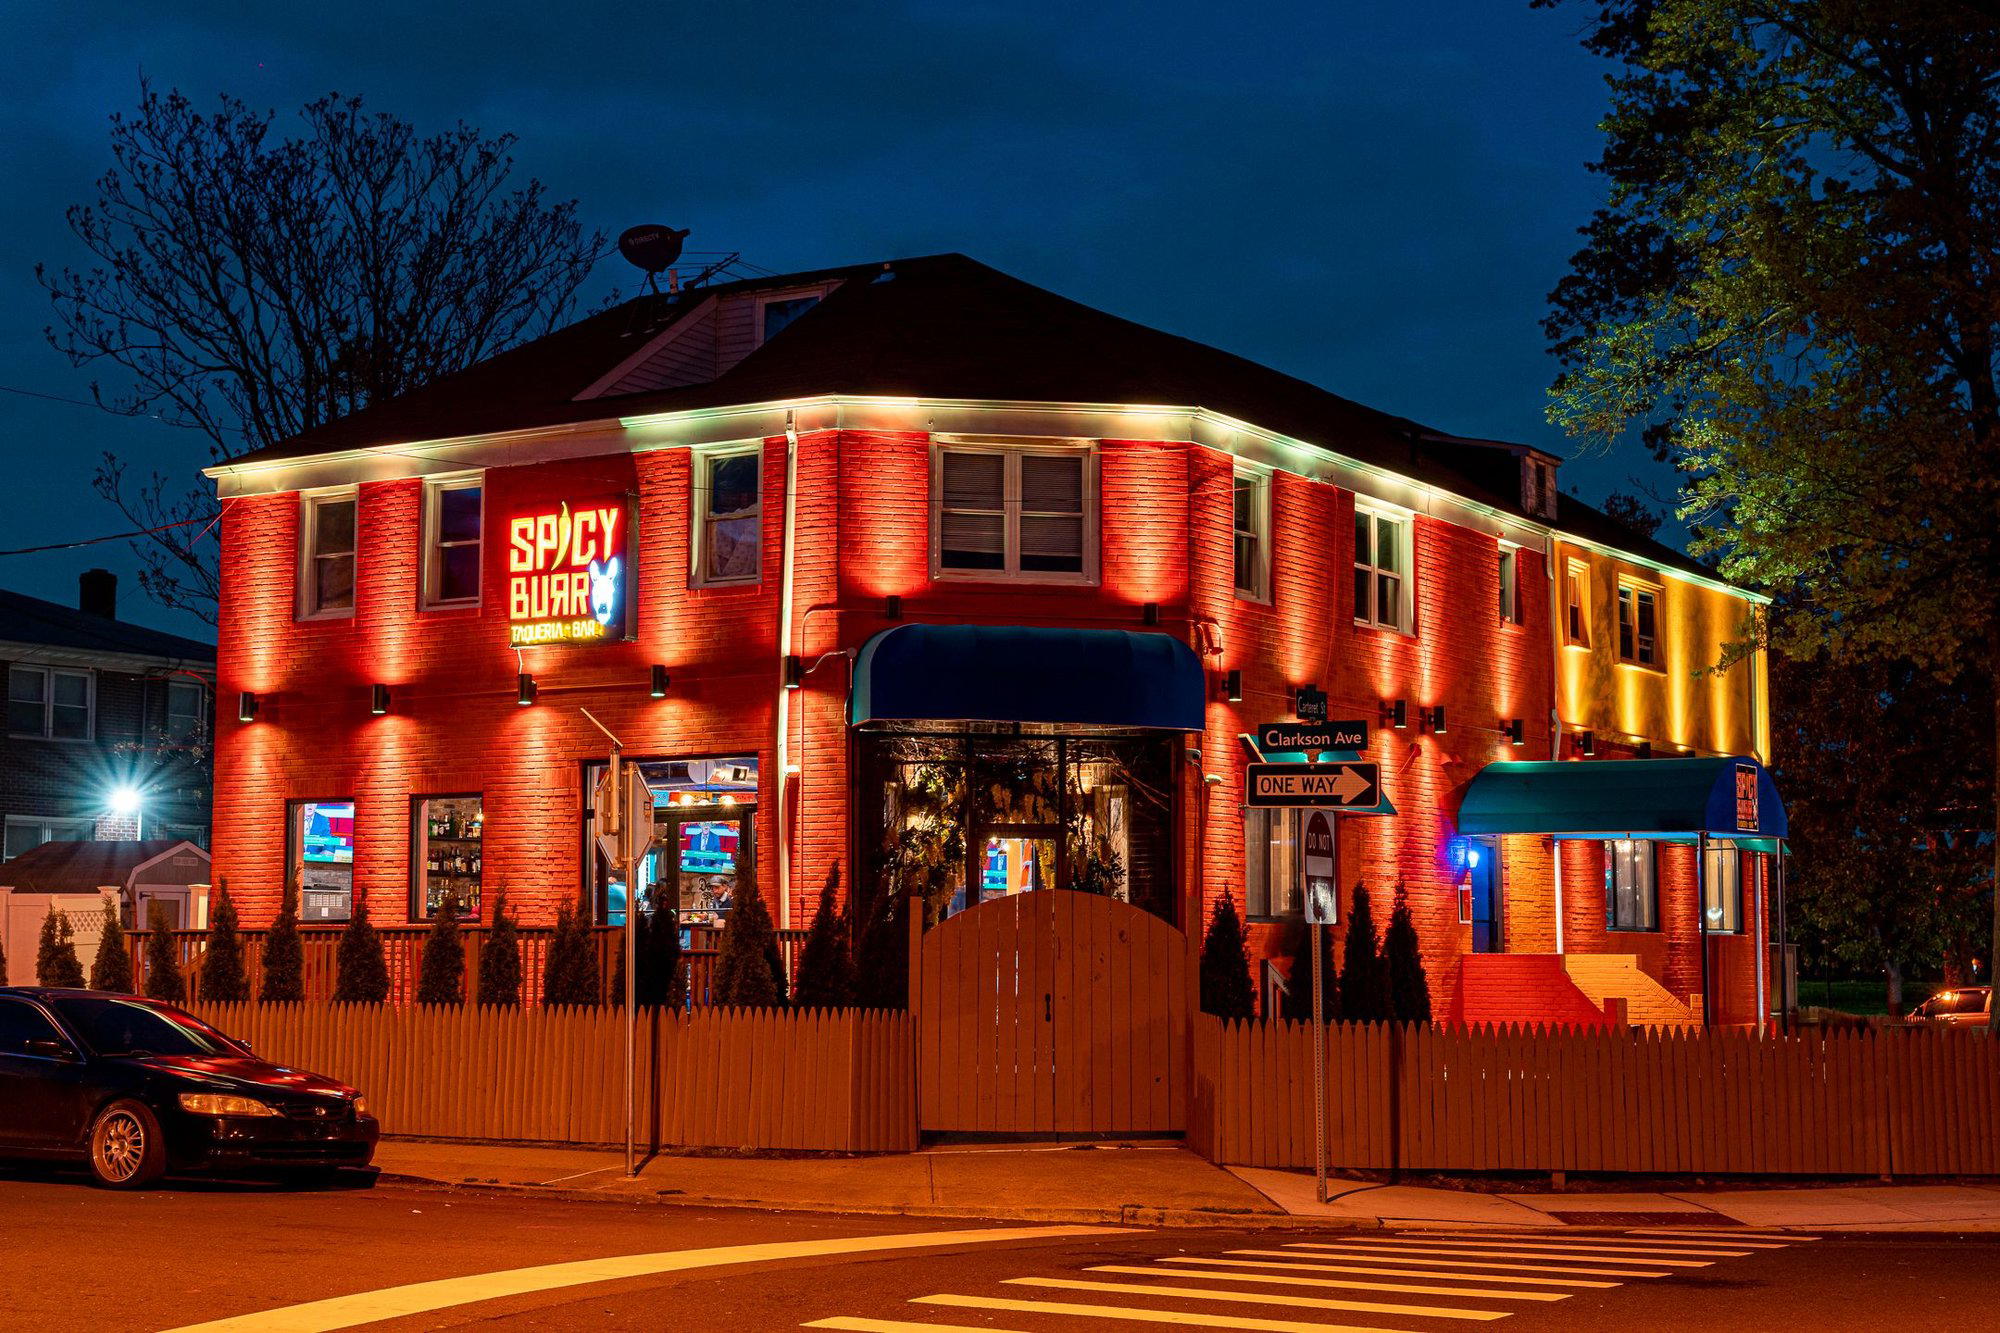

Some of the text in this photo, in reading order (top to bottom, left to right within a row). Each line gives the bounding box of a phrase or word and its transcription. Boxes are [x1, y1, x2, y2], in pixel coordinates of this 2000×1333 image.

[510, 502, 619, 573] SPICY
[511, 619, 596, 643] TAQUERIA BAR
[1265, 730, 1362, 747] Clarkson Ave
[1260, 776, 1338, 793] ONE WAY
[1308, 832, 1330, 851] DO NOT
